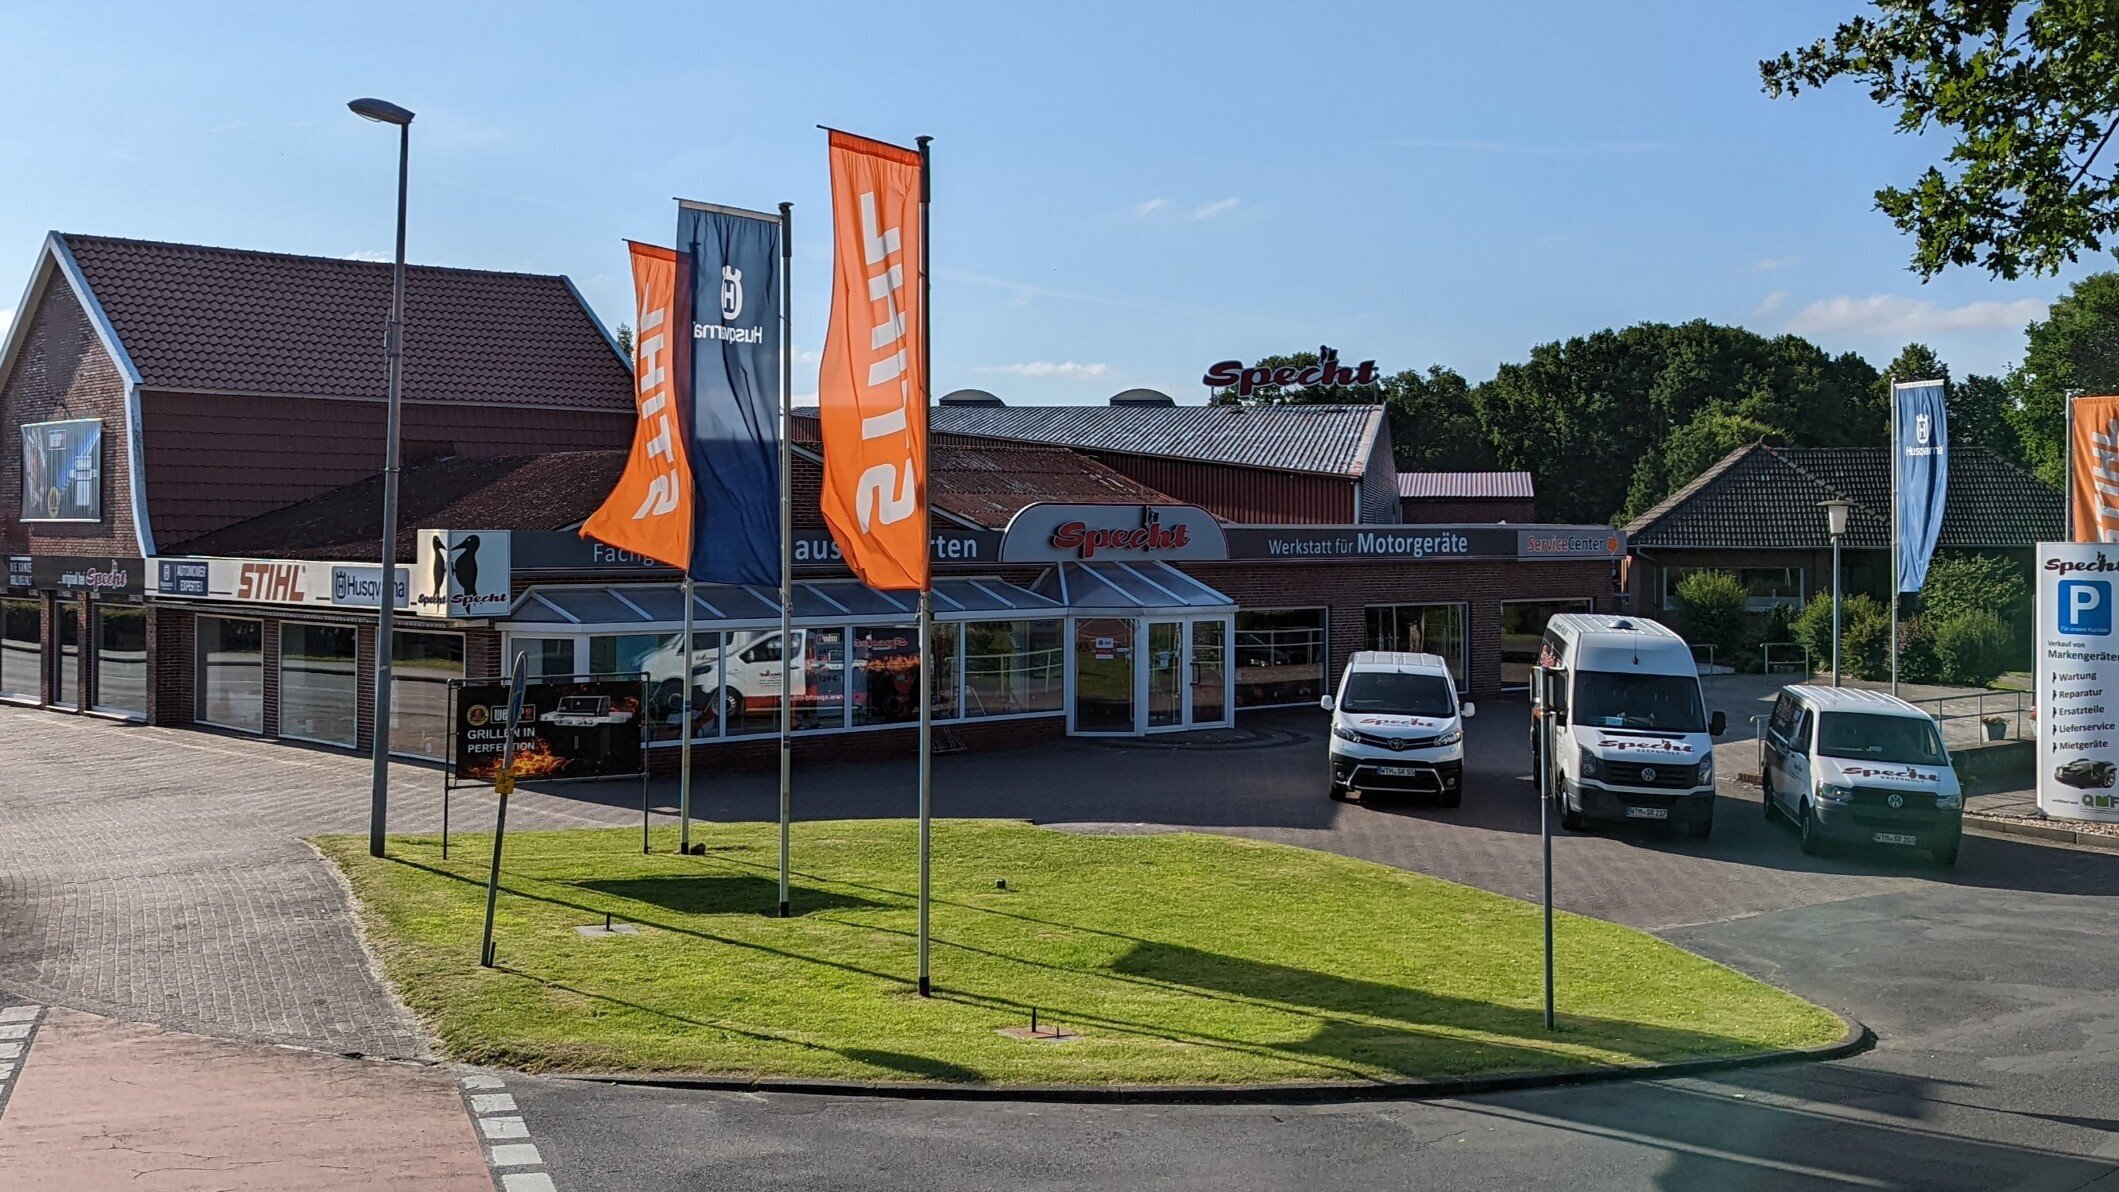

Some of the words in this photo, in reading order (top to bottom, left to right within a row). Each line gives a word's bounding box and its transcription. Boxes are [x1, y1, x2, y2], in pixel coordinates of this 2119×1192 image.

[1203, 359, 1380, 397] Specht
[1906, 444, 1943, 457] Husqvarna
[1053, 520, 1192, 559] Specht
[1268, 539, 1332, 555] Werkstatt
[1335, 538, 1354, 554] für
[1357, 532, 1468, 558] Motorgeräte
[1527, 535, 1604, 552] ServiceCenter
[795, 539, 843, 561] aus
[86, 565, 128, 592] Specht
[237, 563, 305, 602] STIHL
[347, 574, 405, 601] Husqvna
[418, 593, 447, 608] Specht
[451, 592, 508, 607] Specht
[2070, 585, 2100, 625] P
[2059, 672, 2097, 682] Wartung
[2059, 688, 2103, 700] Reparatur
[2059, 705, 2105, 716] Ersatzteile
[523, 727, 535, 738] IN
[2059, 722, 2115, 733] Lieferservice
[467, 742, 535, 754] PERFETION
[2059, 739, 2108, 752] Mietgeräte
